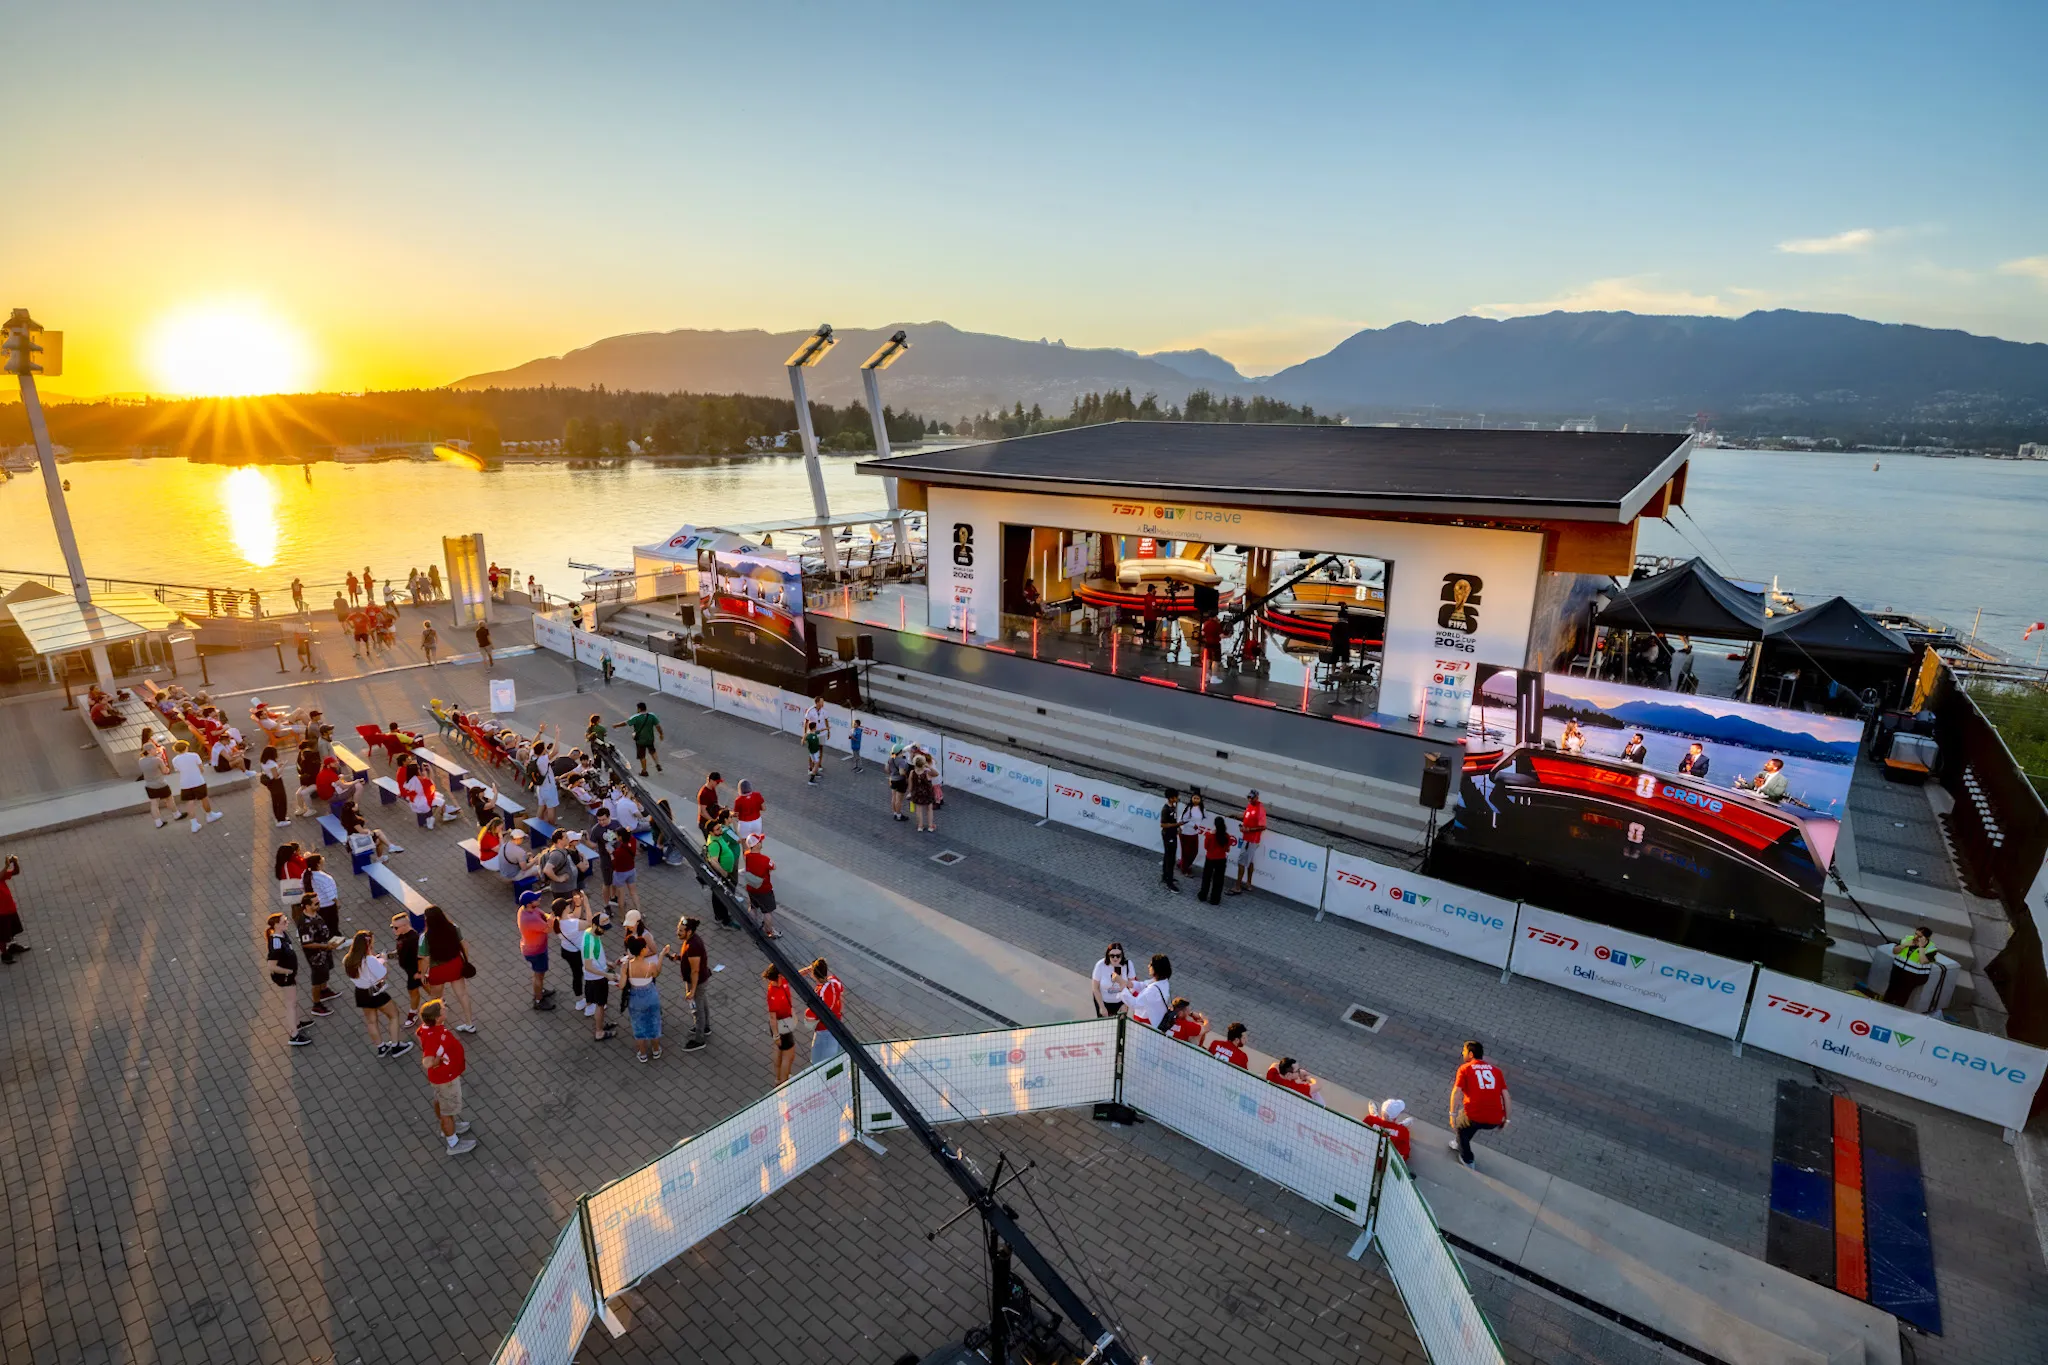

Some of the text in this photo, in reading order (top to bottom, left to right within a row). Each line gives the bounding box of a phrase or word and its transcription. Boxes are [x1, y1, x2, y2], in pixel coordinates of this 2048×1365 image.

[1112, 503, 1145, 516] TSN
[1154, 506, 1186, 520] CTV
[953, 571, 974, 580] 2026
[954, 585, 973, 594] TSN
[1448, 620, 1468, 630] FIFA
[1435, 637, 1475, 653] 2026
[1436, 631, 1476, 644] WORLD CUP
[1435, 660, 1470, 671] TSN
[1433, 673, 1467, 686] CTV
[716, 683, 732, 694] TSN
[783, 702, 800, 713] TSN
[948, 751, 972, 766] TSN
[979, 760, 1002, 775] CTV
[1592, 768, 1632, 785] TSN
[1054, 784, 1084, 799] TSN
[1092, 794, 1120, 809] CTV
[1336, 870, 1377, 892] TSN
[1389, 887, 1432, 907] CTV
[1414, 920, 1450, 938] company
[1527, 926, 1579, 951] TSN
[1594, 946, 1646, 969] CTV
[1624, 983, 1667, 1002] company
[1767, 994, 1831, 1024] TSN
[1850, 1020, 1915, 1048] CTV
[1811, 1039, 1819, 1048] A
[1885, 1063, 1938, 1088] company
[1475, 1070, 1495, 1089] 19
